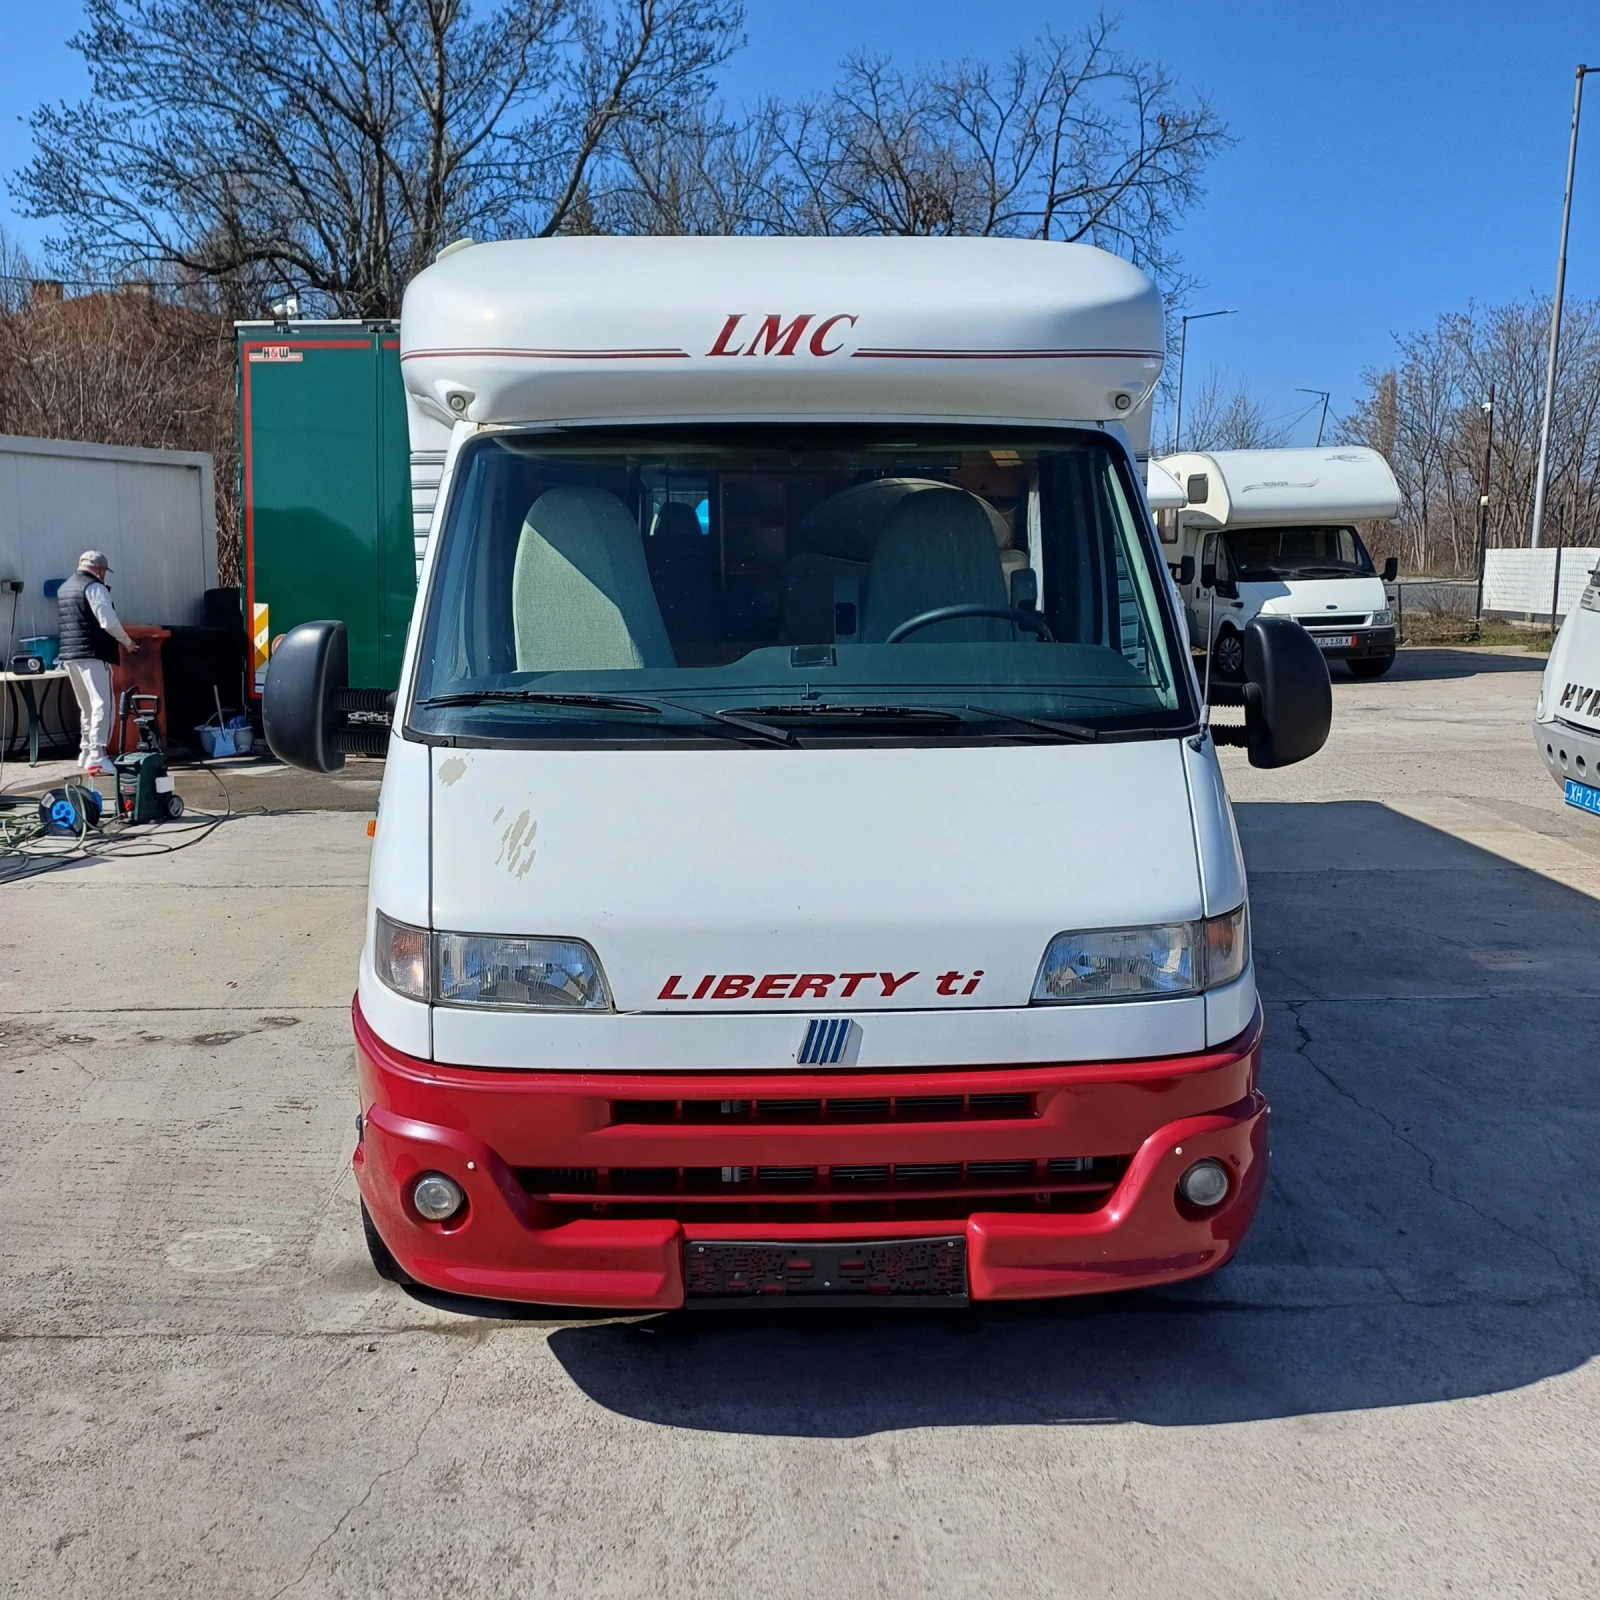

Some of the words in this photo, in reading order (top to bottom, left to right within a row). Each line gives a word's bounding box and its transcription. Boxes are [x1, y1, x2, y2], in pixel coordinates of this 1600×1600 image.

[705, 313, 859, 357] LMC
[263, 347, 289, 359] H&W
[1569, 783, 1583, 804] XH
[657, 971, 920, 1000] LIBERTY
[935, 969, 985, 996] ti
